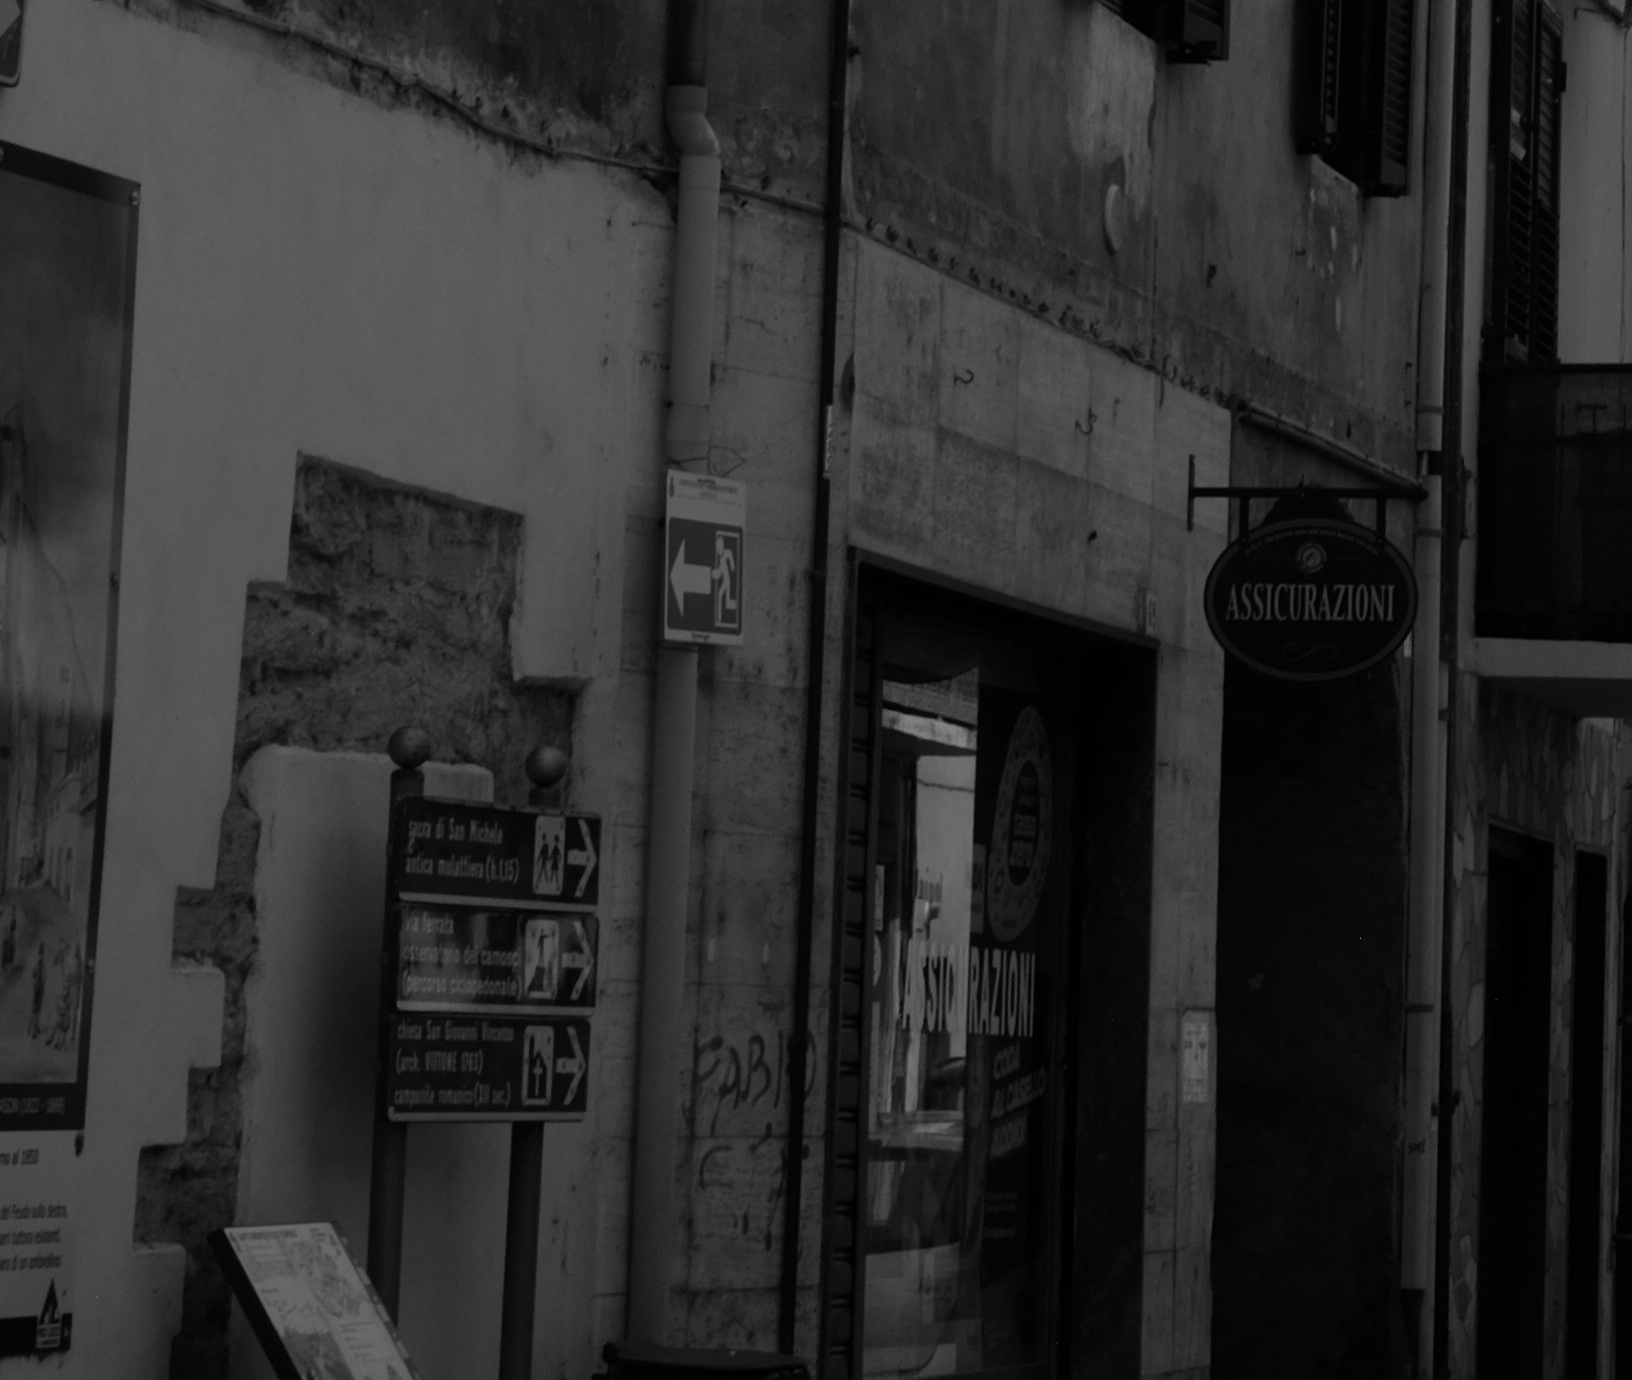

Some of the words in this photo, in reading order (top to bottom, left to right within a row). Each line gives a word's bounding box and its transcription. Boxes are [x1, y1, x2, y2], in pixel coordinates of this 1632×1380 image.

[1225, 582, 1396, 623] ASSICURAZIONI
[435, 816, 445, 839] di
[448, 817, 466, 841] San
[469, 819, 503, 845] Michele
[405, 853, 434, 875] antica
[397, 1019, 422, 1041] chiesa
[426, 1019, 441, 1041] San
[445, 1019, 479, 1041] Giovanni
[481, 1021, 515, 1042] Vincenzo
[438, 1088, 474, 1105] romanico
